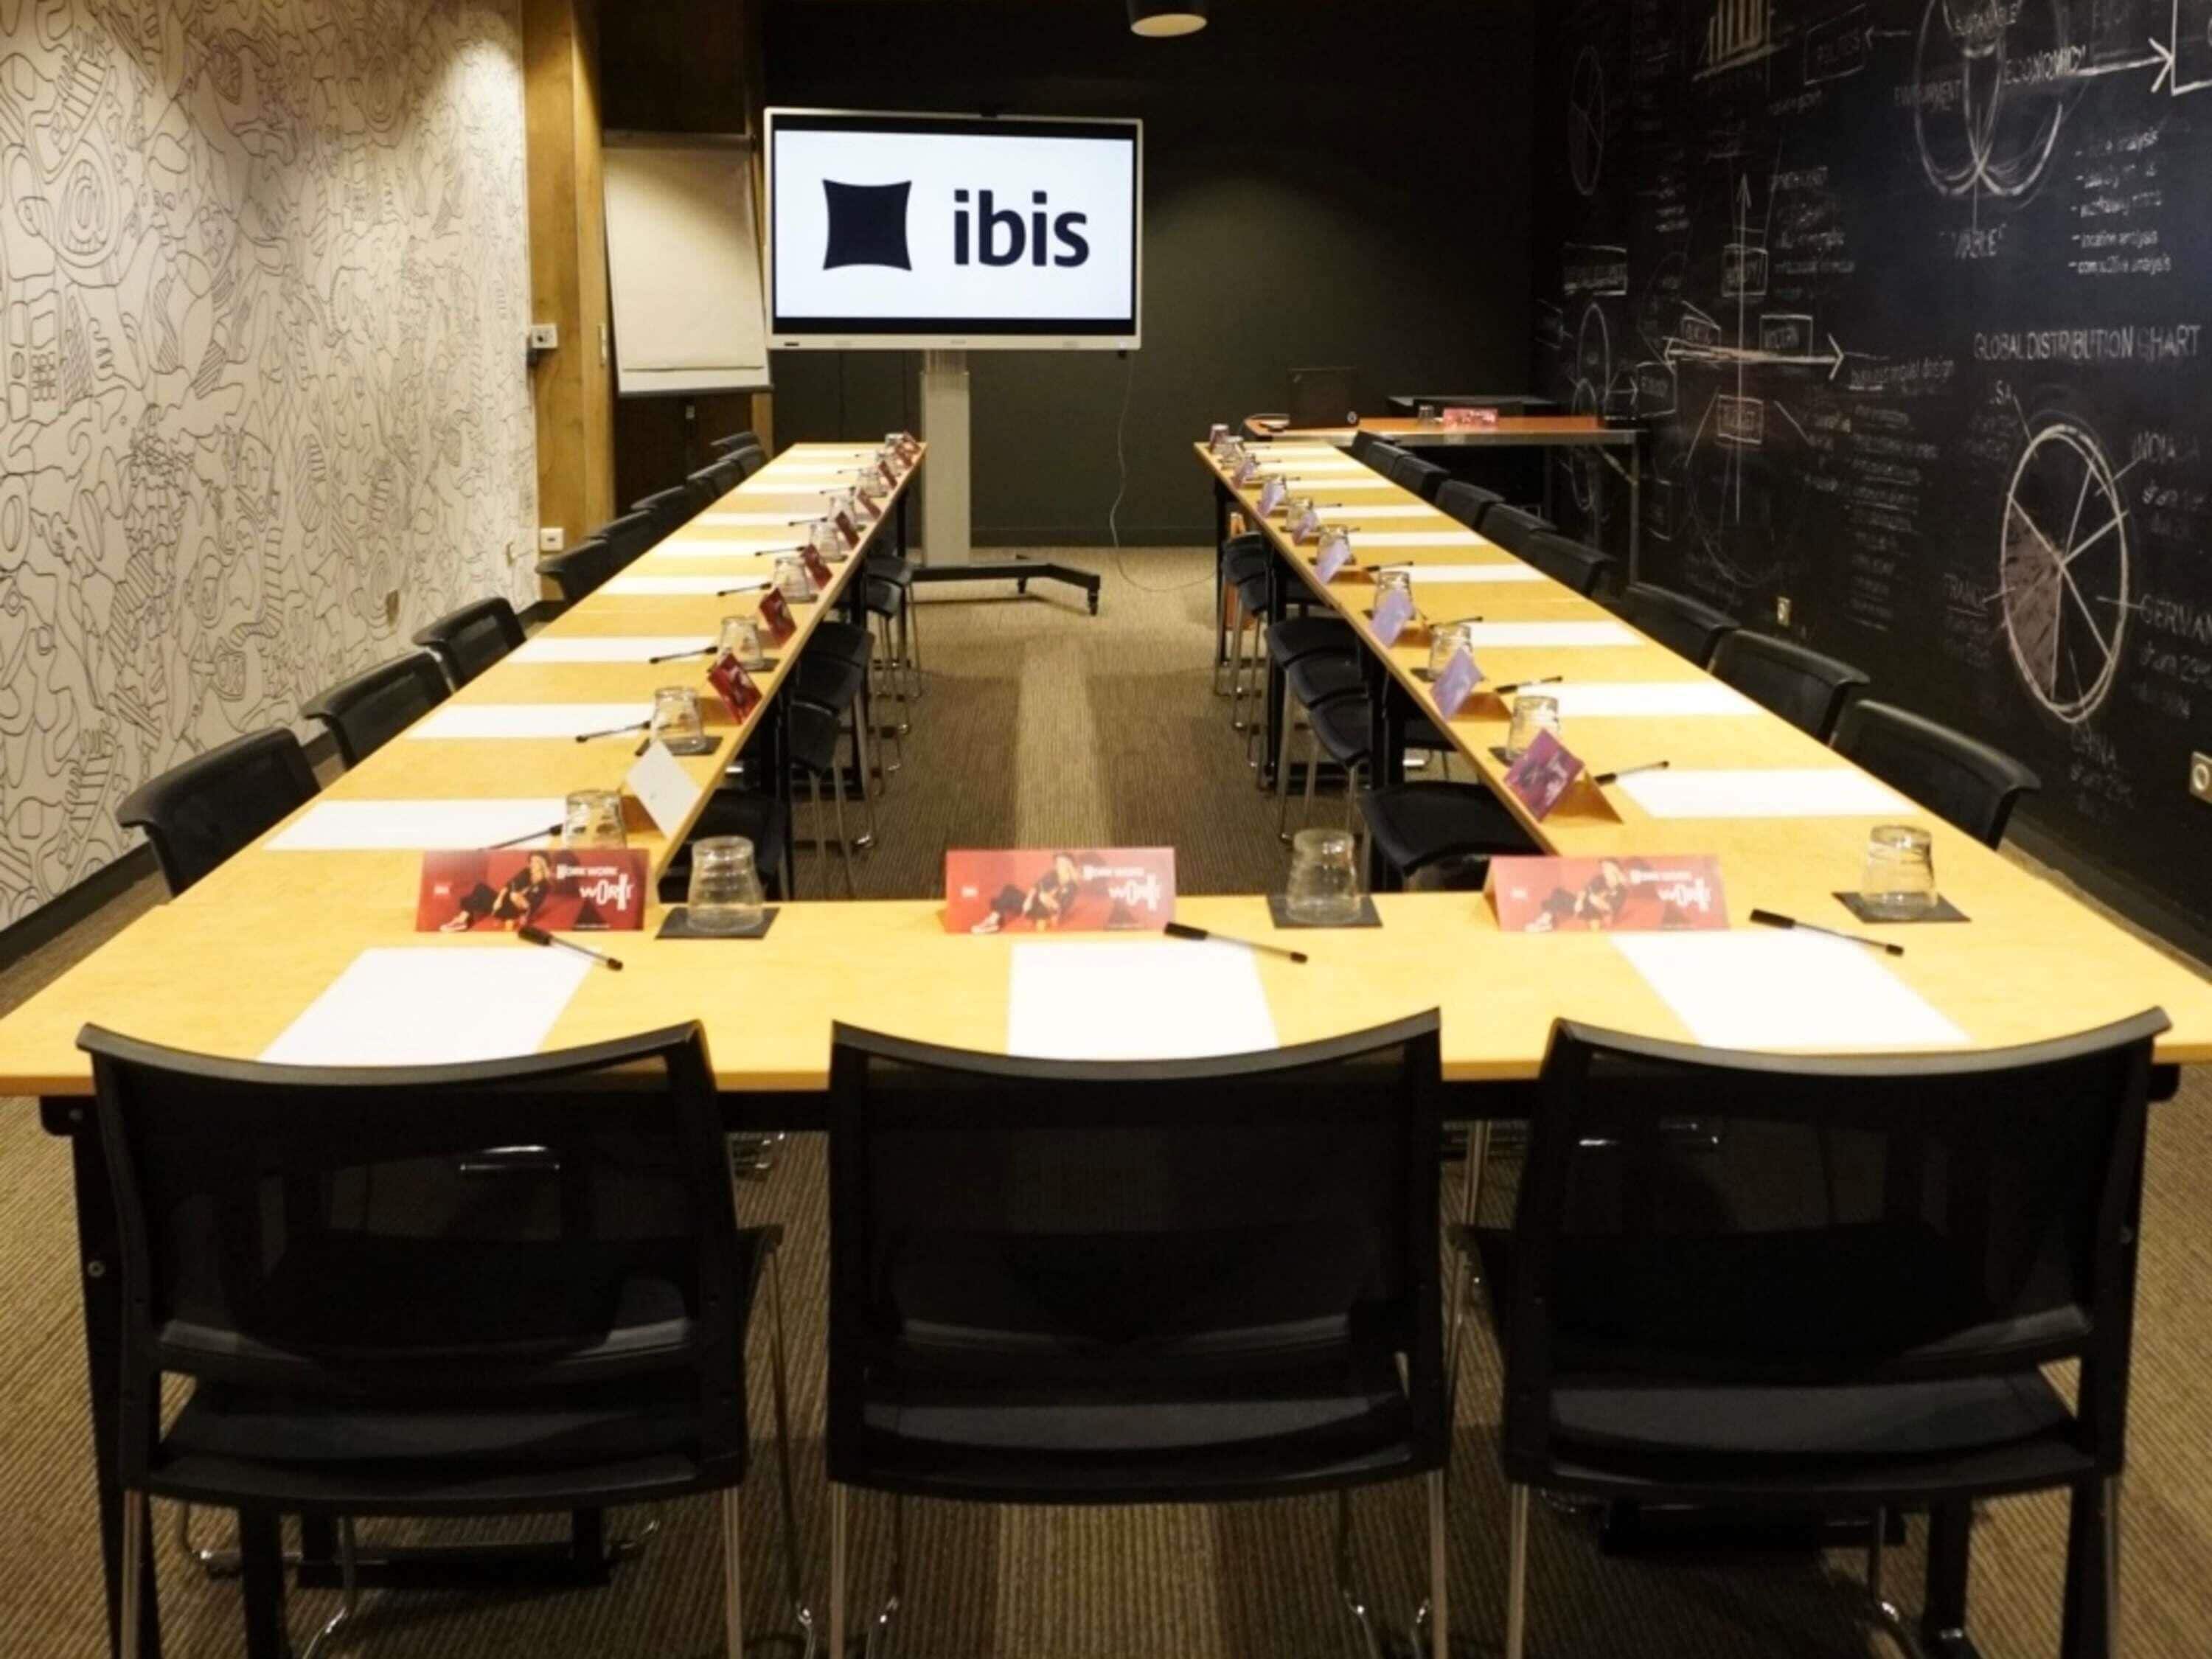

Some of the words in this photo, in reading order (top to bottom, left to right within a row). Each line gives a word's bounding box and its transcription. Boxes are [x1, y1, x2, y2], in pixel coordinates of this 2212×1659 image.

[954, 189, 1090, 268] ibis
[1974, 332, 2024, 360] GLOBAL
[2026, 325, 2135, 361] DISTRIBUTION
